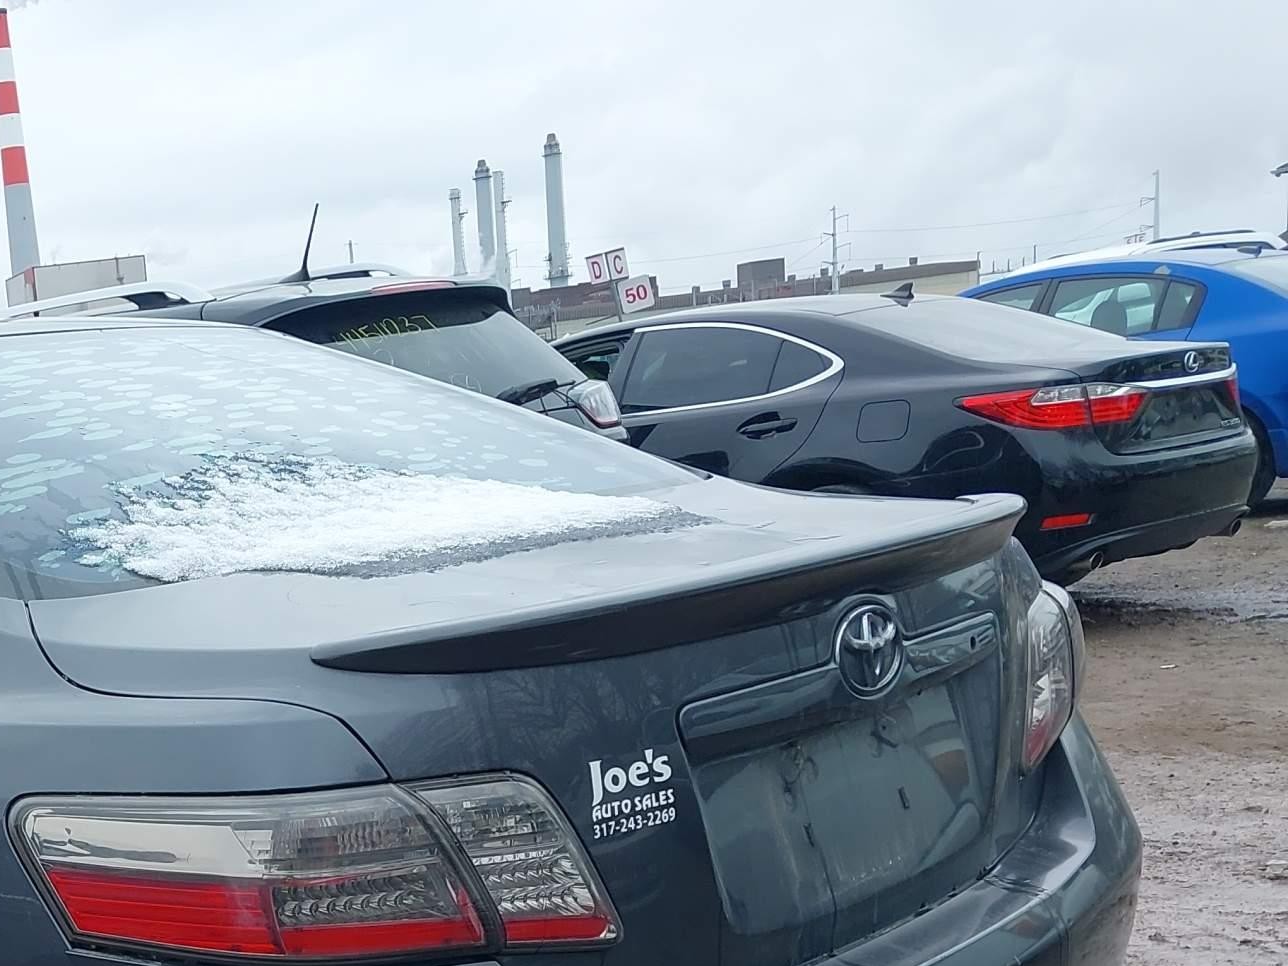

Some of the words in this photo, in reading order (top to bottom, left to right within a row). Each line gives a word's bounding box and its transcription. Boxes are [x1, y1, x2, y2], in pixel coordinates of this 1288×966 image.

[591, 261, 602, 280] D
[613, 254, 624, 275] C
[625, 284, 648, 304] 50
[588, 749, 672, 807] Joe's
[592, 799, 632, 823] AUTO
[635, 788, 675, 812] SALES
[593, 807, 676, 839] 317-243-2269
